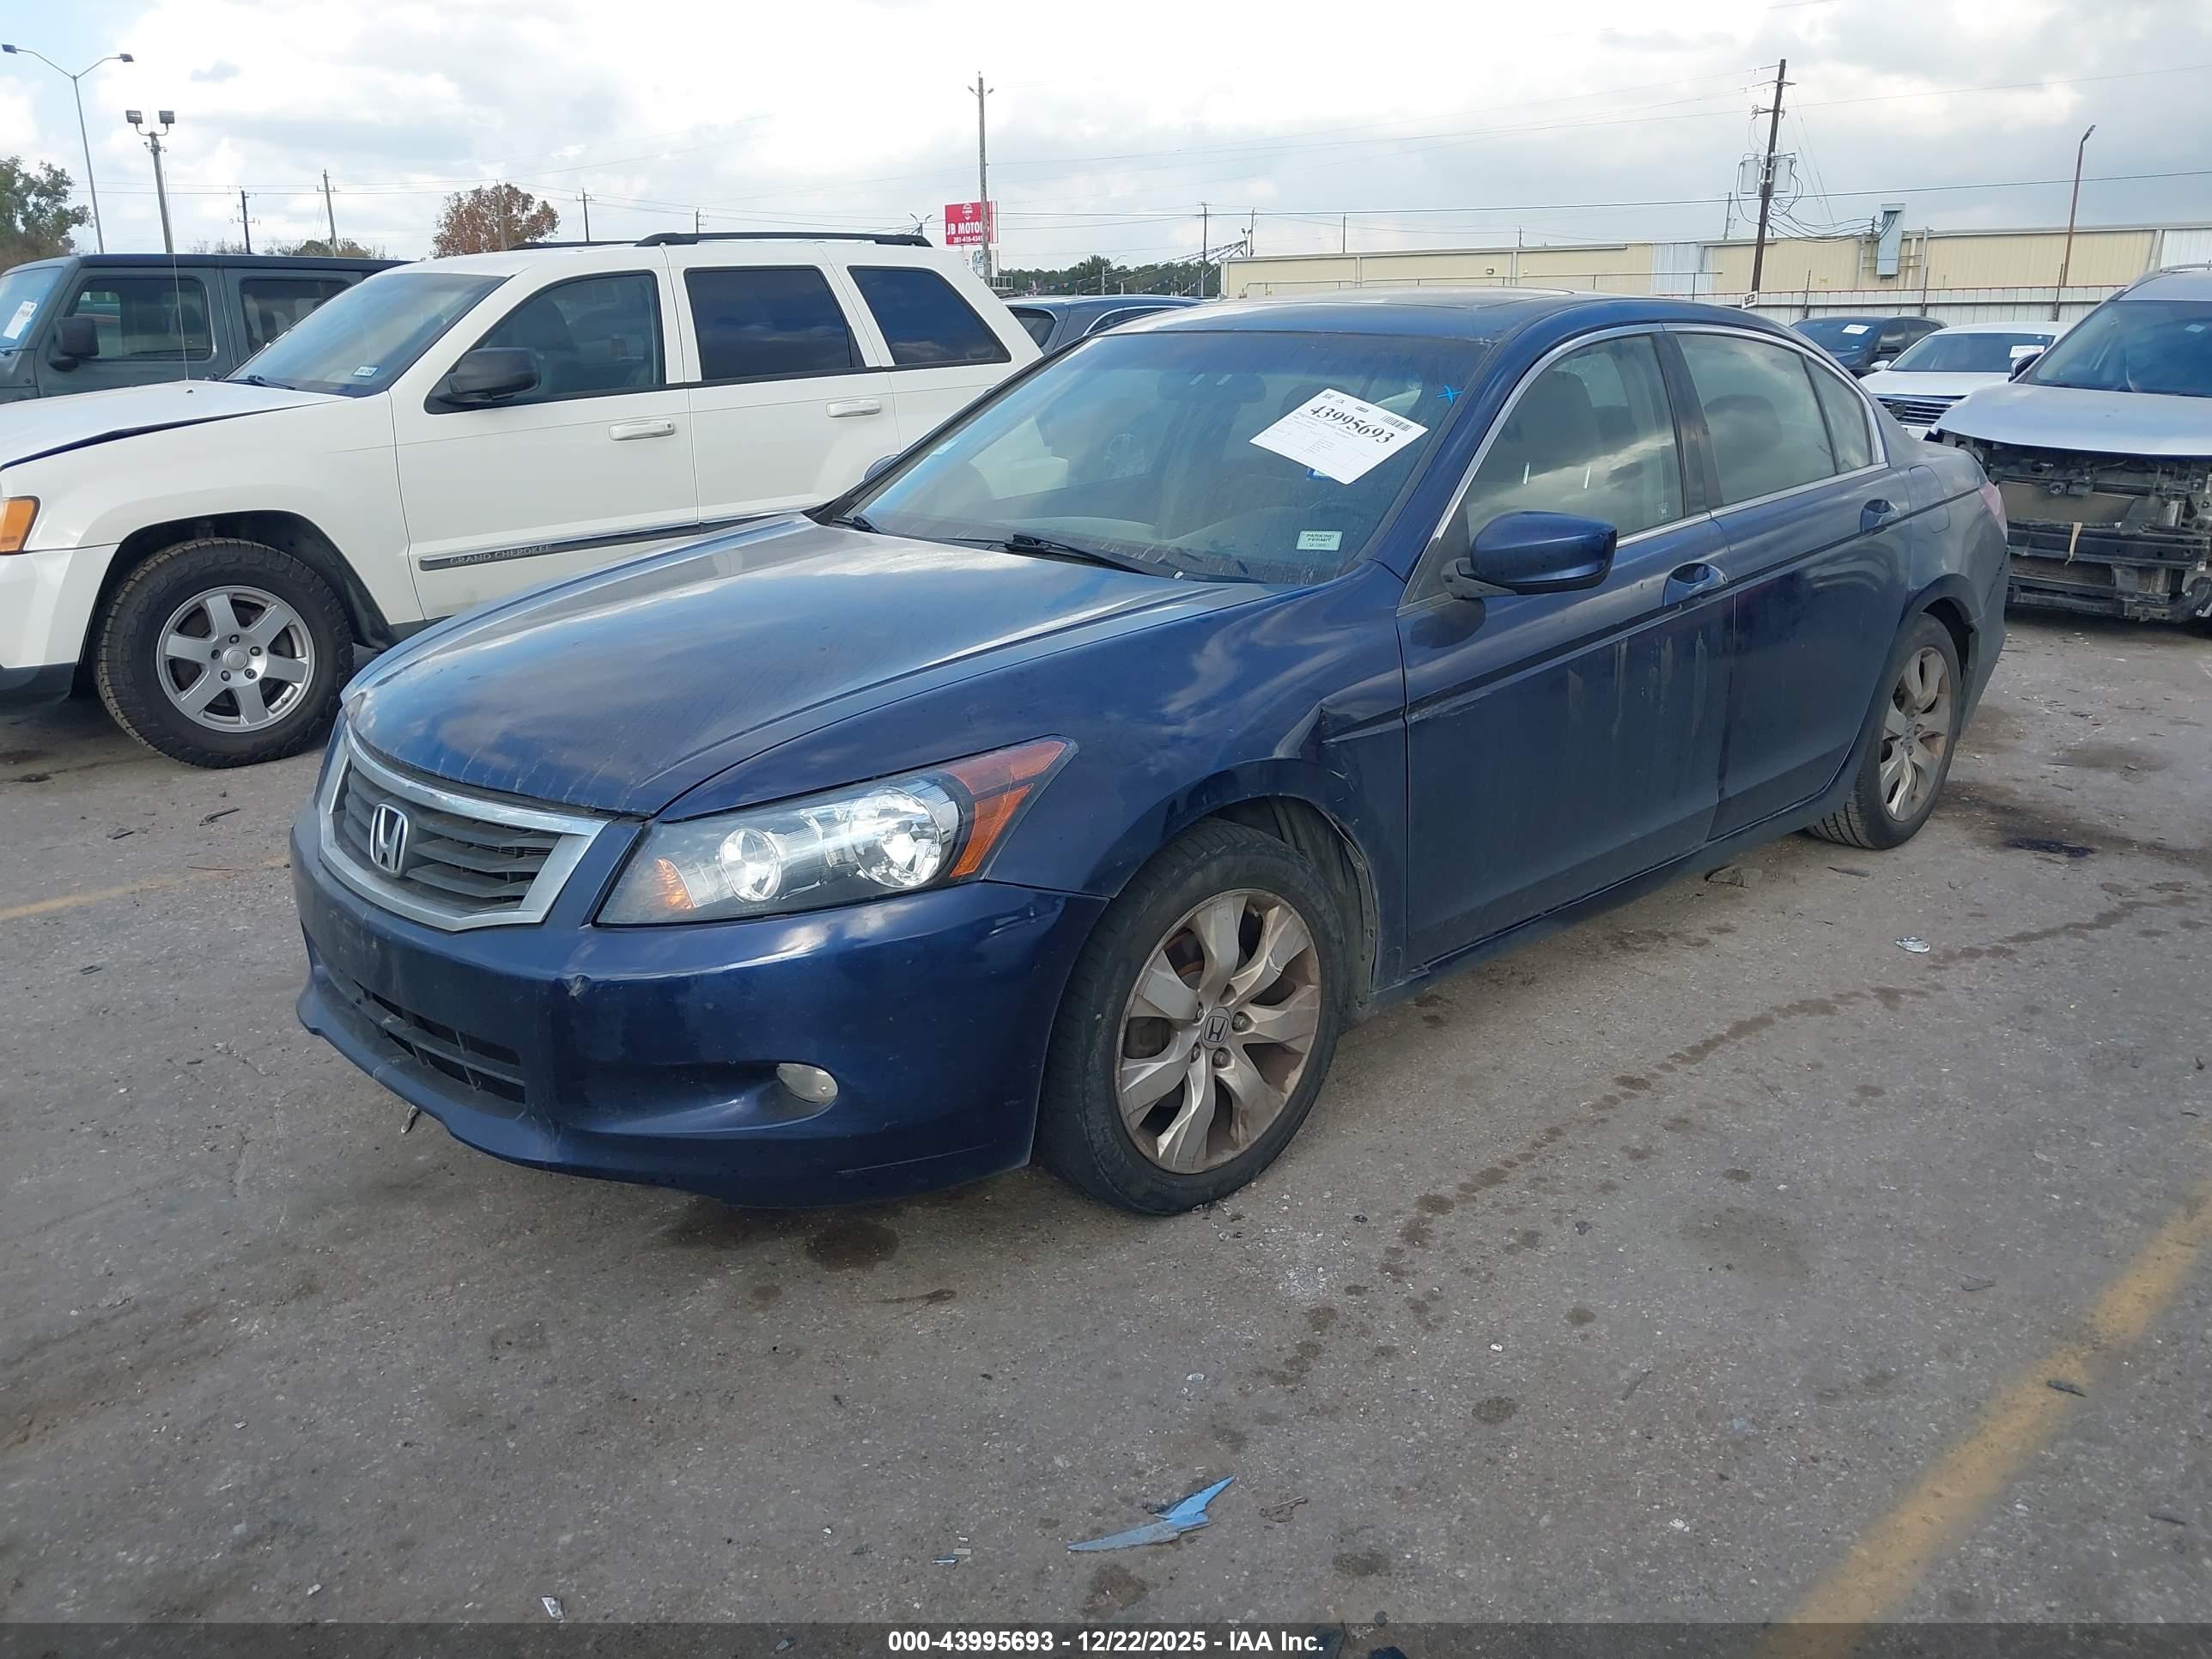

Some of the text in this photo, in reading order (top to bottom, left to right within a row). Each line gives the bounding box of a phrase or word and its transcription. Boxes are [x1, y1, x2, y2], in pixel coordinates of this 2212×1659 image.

[947, 222, 956, 235] JB
[1310, 404, 1395, 444] 43995693
[450, 544, 552, 565] GRAND CHEROKEE
